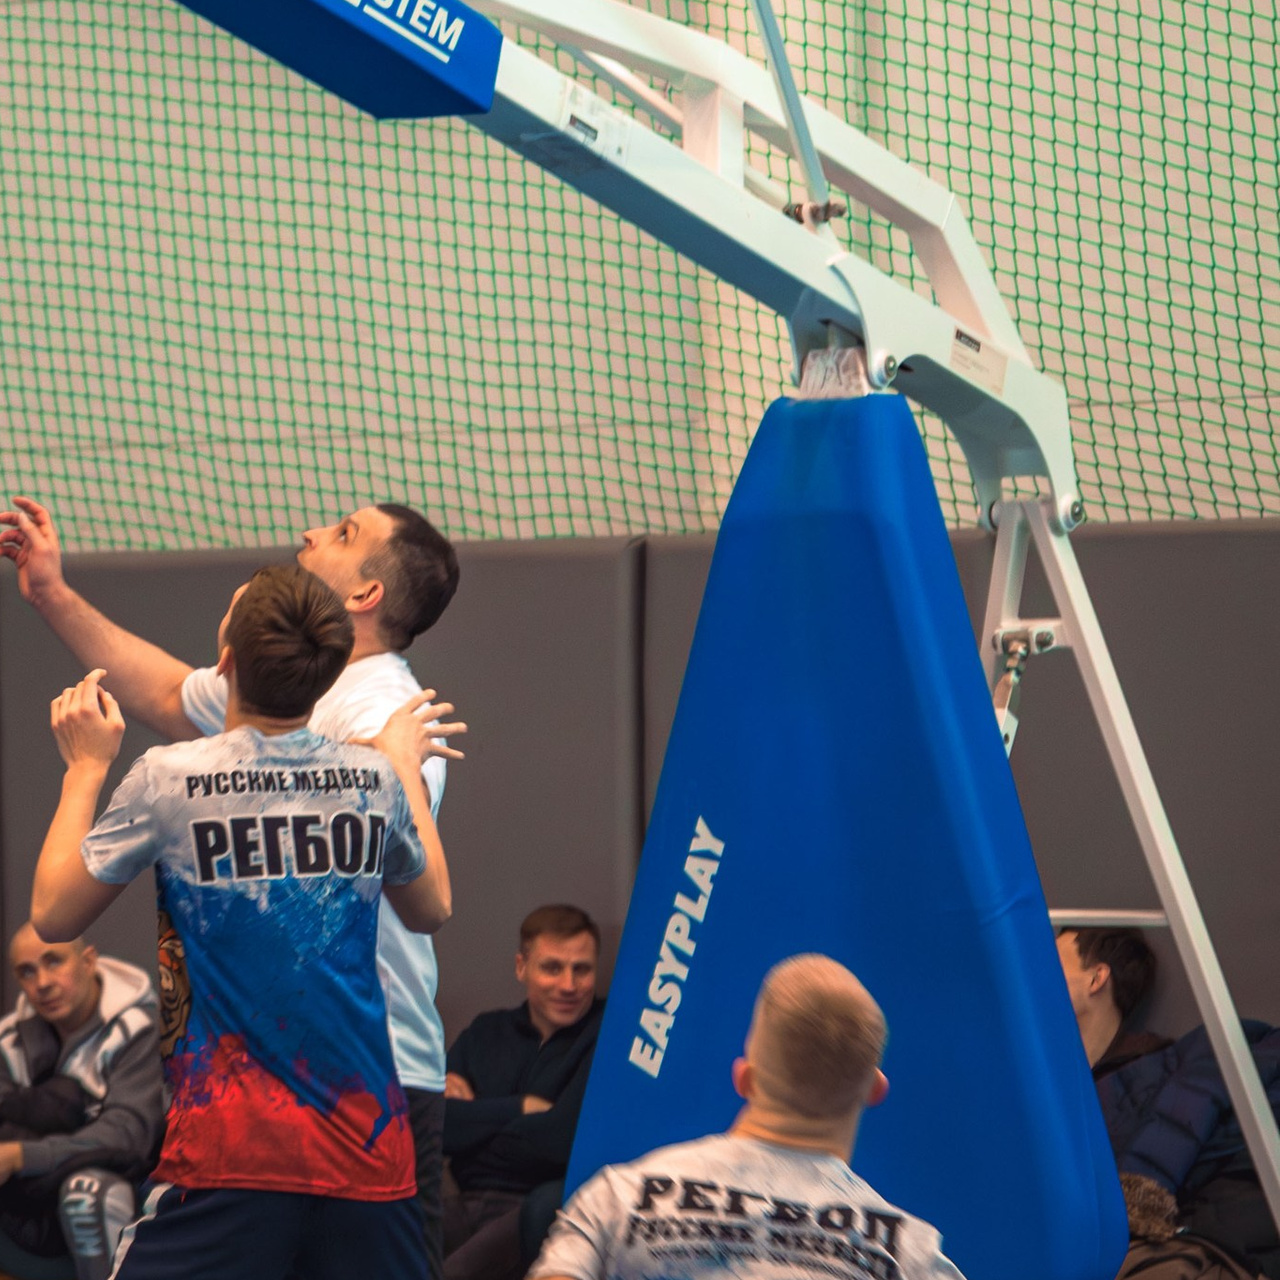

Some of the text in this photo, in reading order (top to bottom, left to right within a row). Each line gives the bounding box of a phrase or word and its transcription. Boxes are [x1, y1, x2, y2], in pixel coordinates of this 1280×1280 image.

[186, 770, 288, 799] РУССКИЕ
[190, 810, 387, 885] РЕГБОЛ
[629, 815, 726, 1079] EASYPLAY
